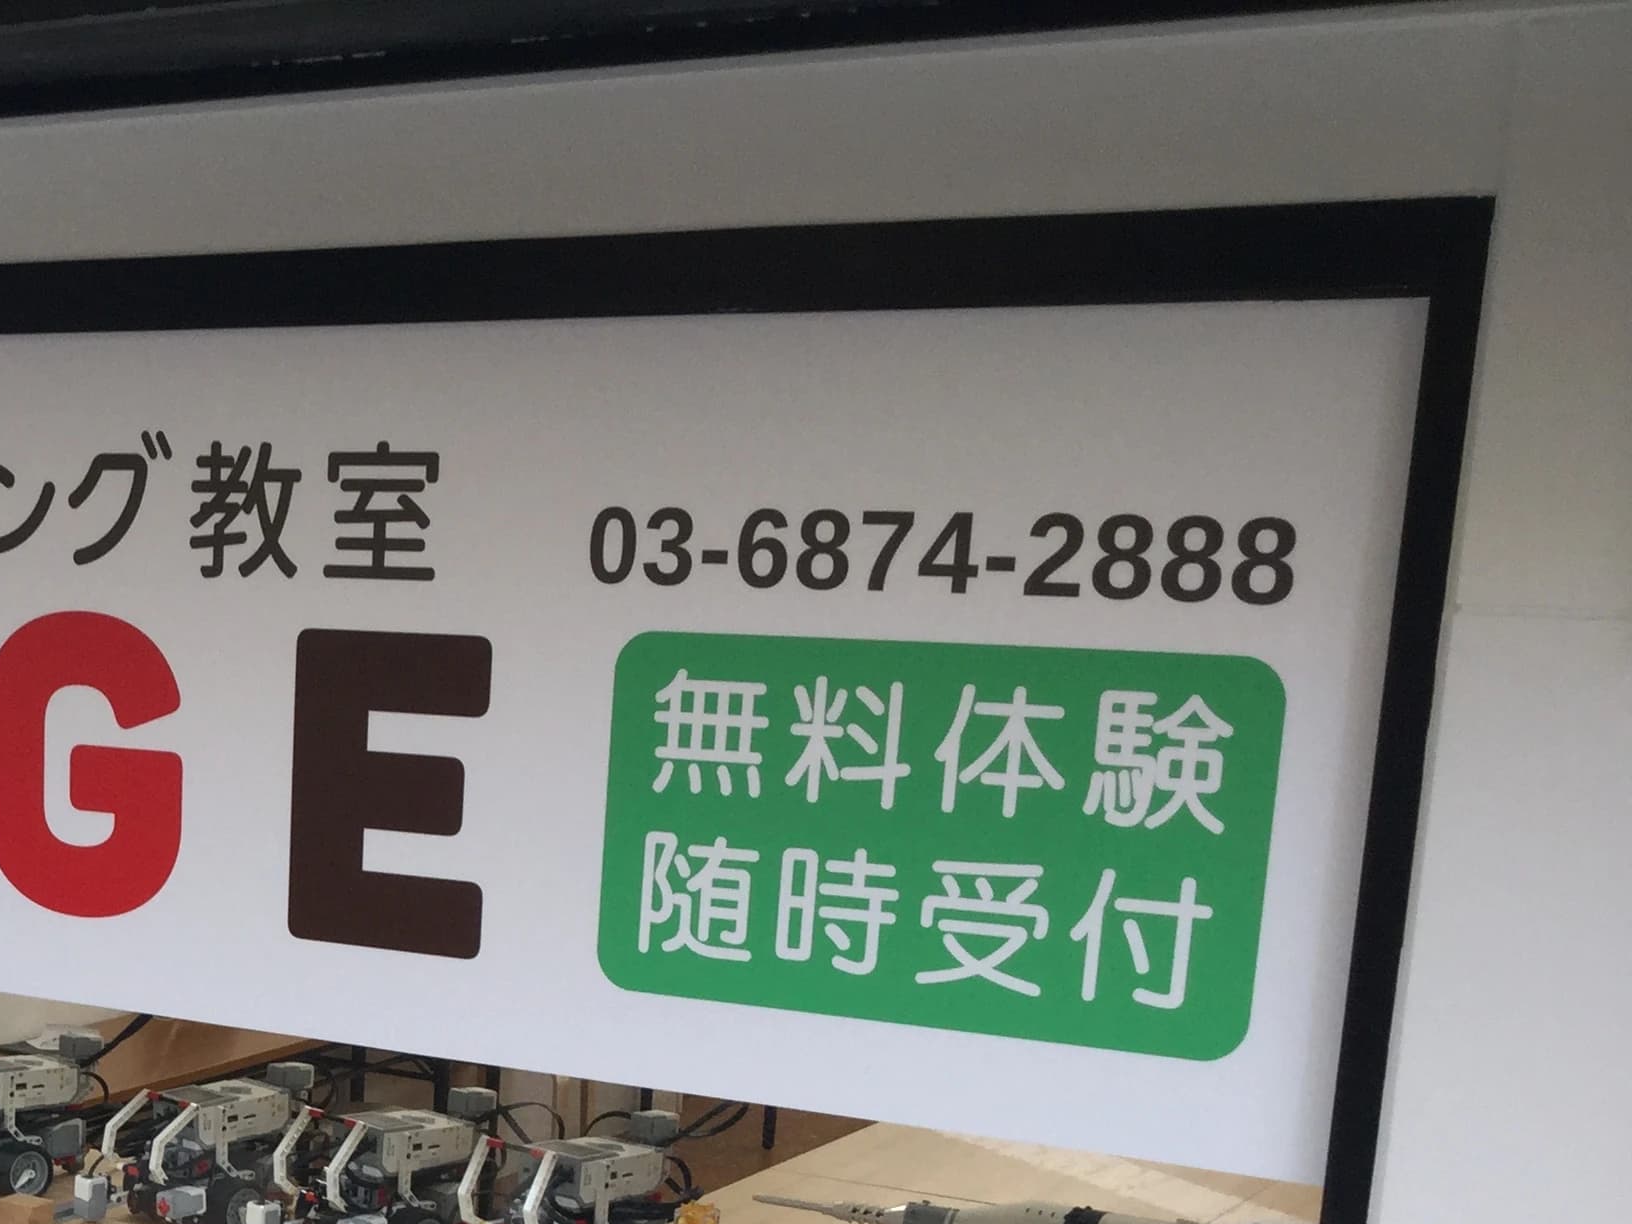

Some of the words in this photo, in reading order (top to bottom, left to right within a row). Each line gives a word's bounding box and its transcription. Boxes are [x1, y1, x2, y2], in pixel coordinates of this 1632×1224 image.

[589, 506, 1297, 606] 03-6874-2888
[651, 668, 1234, 835] 無料体験
[638, 831, 1214, 1010] 随時受付
